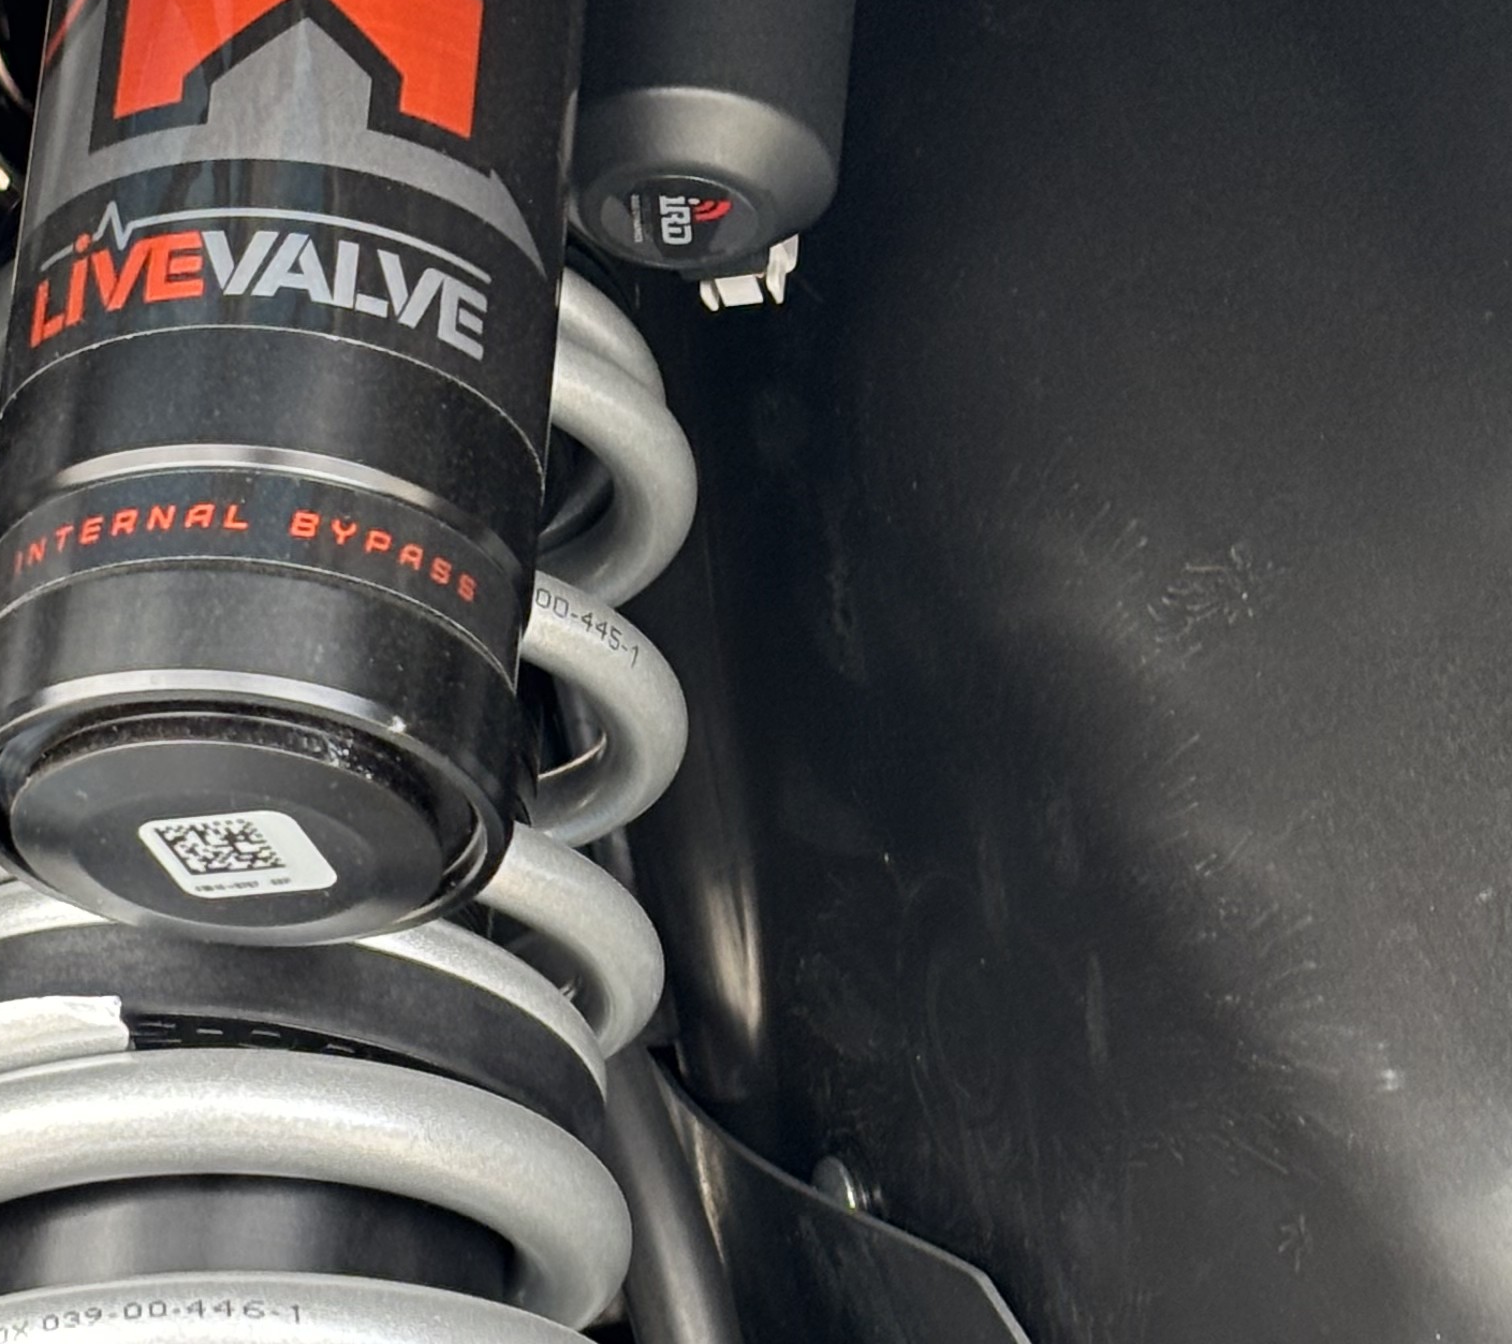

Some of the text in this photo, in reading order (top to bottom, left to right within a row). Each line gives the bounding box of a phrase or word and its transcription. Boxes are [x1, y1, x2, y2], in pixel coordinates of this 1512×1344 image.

[13, 502, 478, 604] INTERNAL BYPASS
[535, 587, 640, 669] 00-445-1
[42, 1299, 300, 1332] 039-00-446-1
